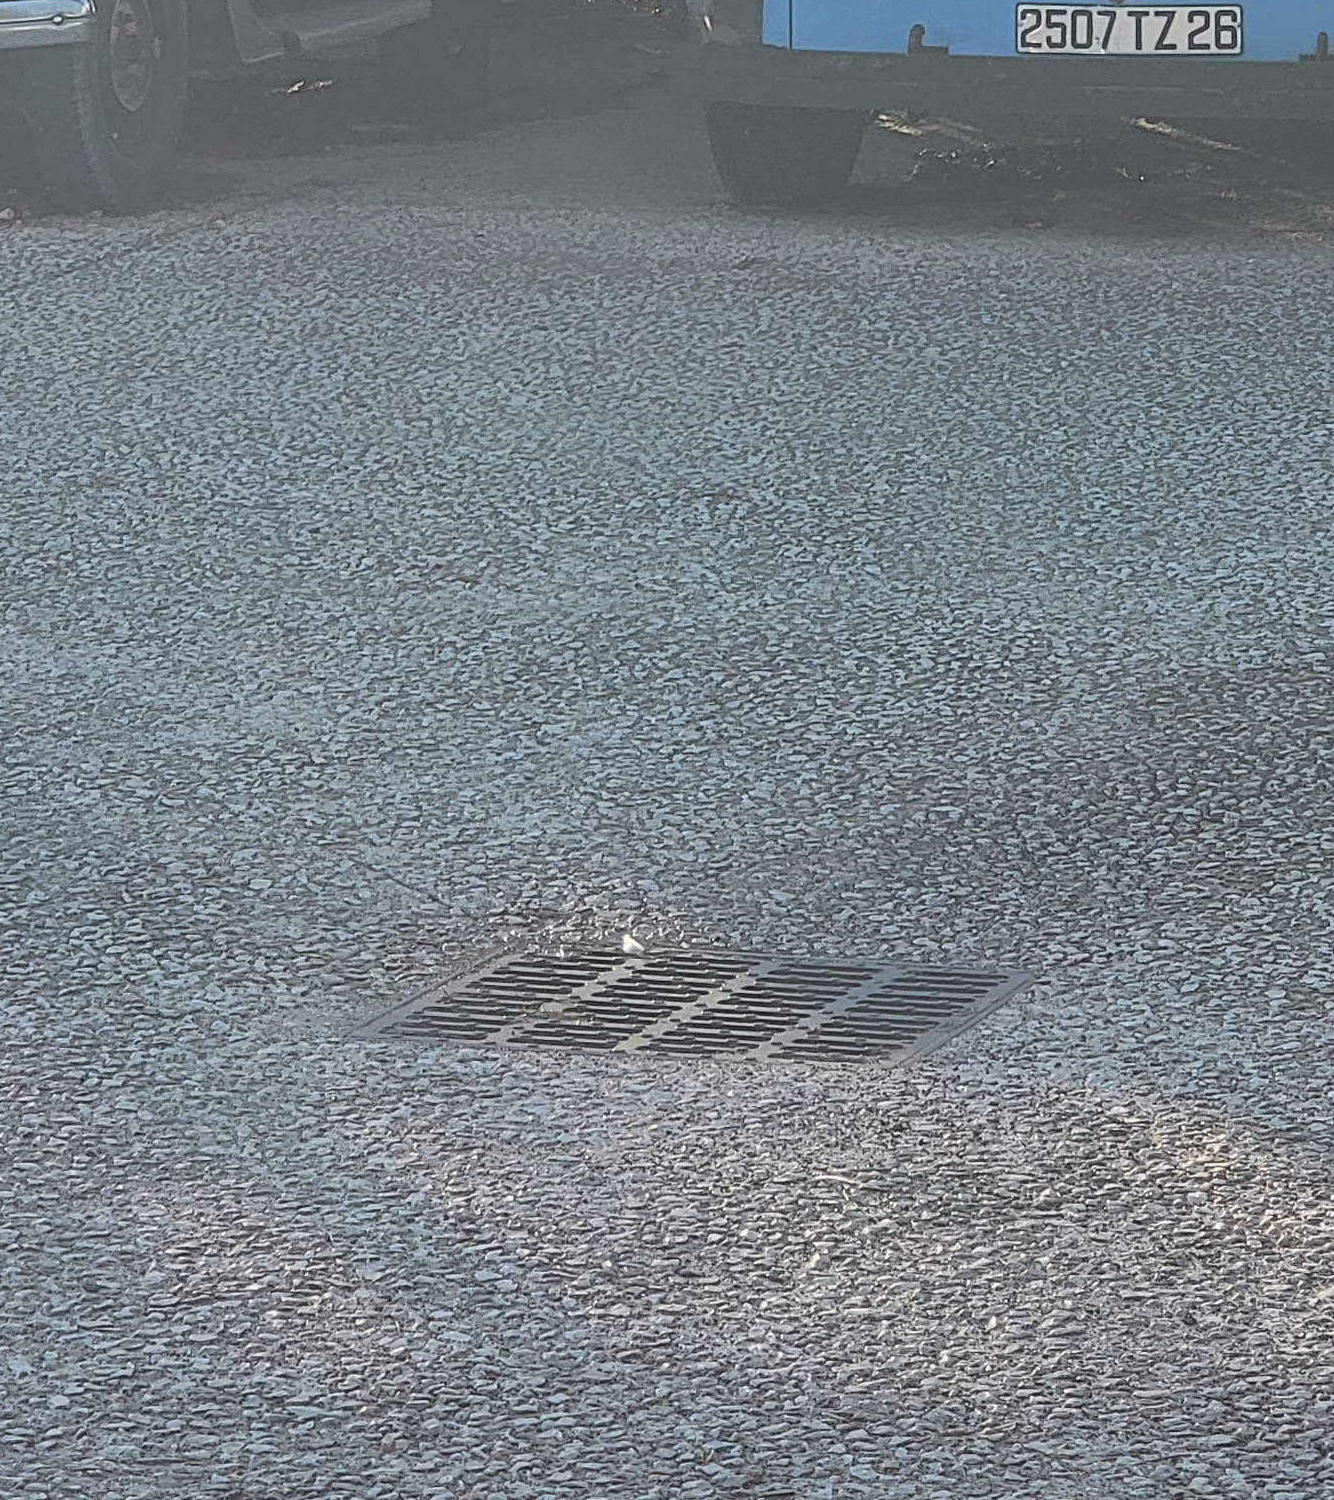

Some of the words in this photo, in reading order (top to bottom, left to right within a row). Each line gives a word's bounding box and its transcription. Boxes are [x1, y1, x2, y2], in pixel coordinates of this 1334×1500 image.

[1020, 9, 1117, 49] 2507
[1127, 10, 1177, 50] TZ
[1188, 10, 1238, 50] 26
